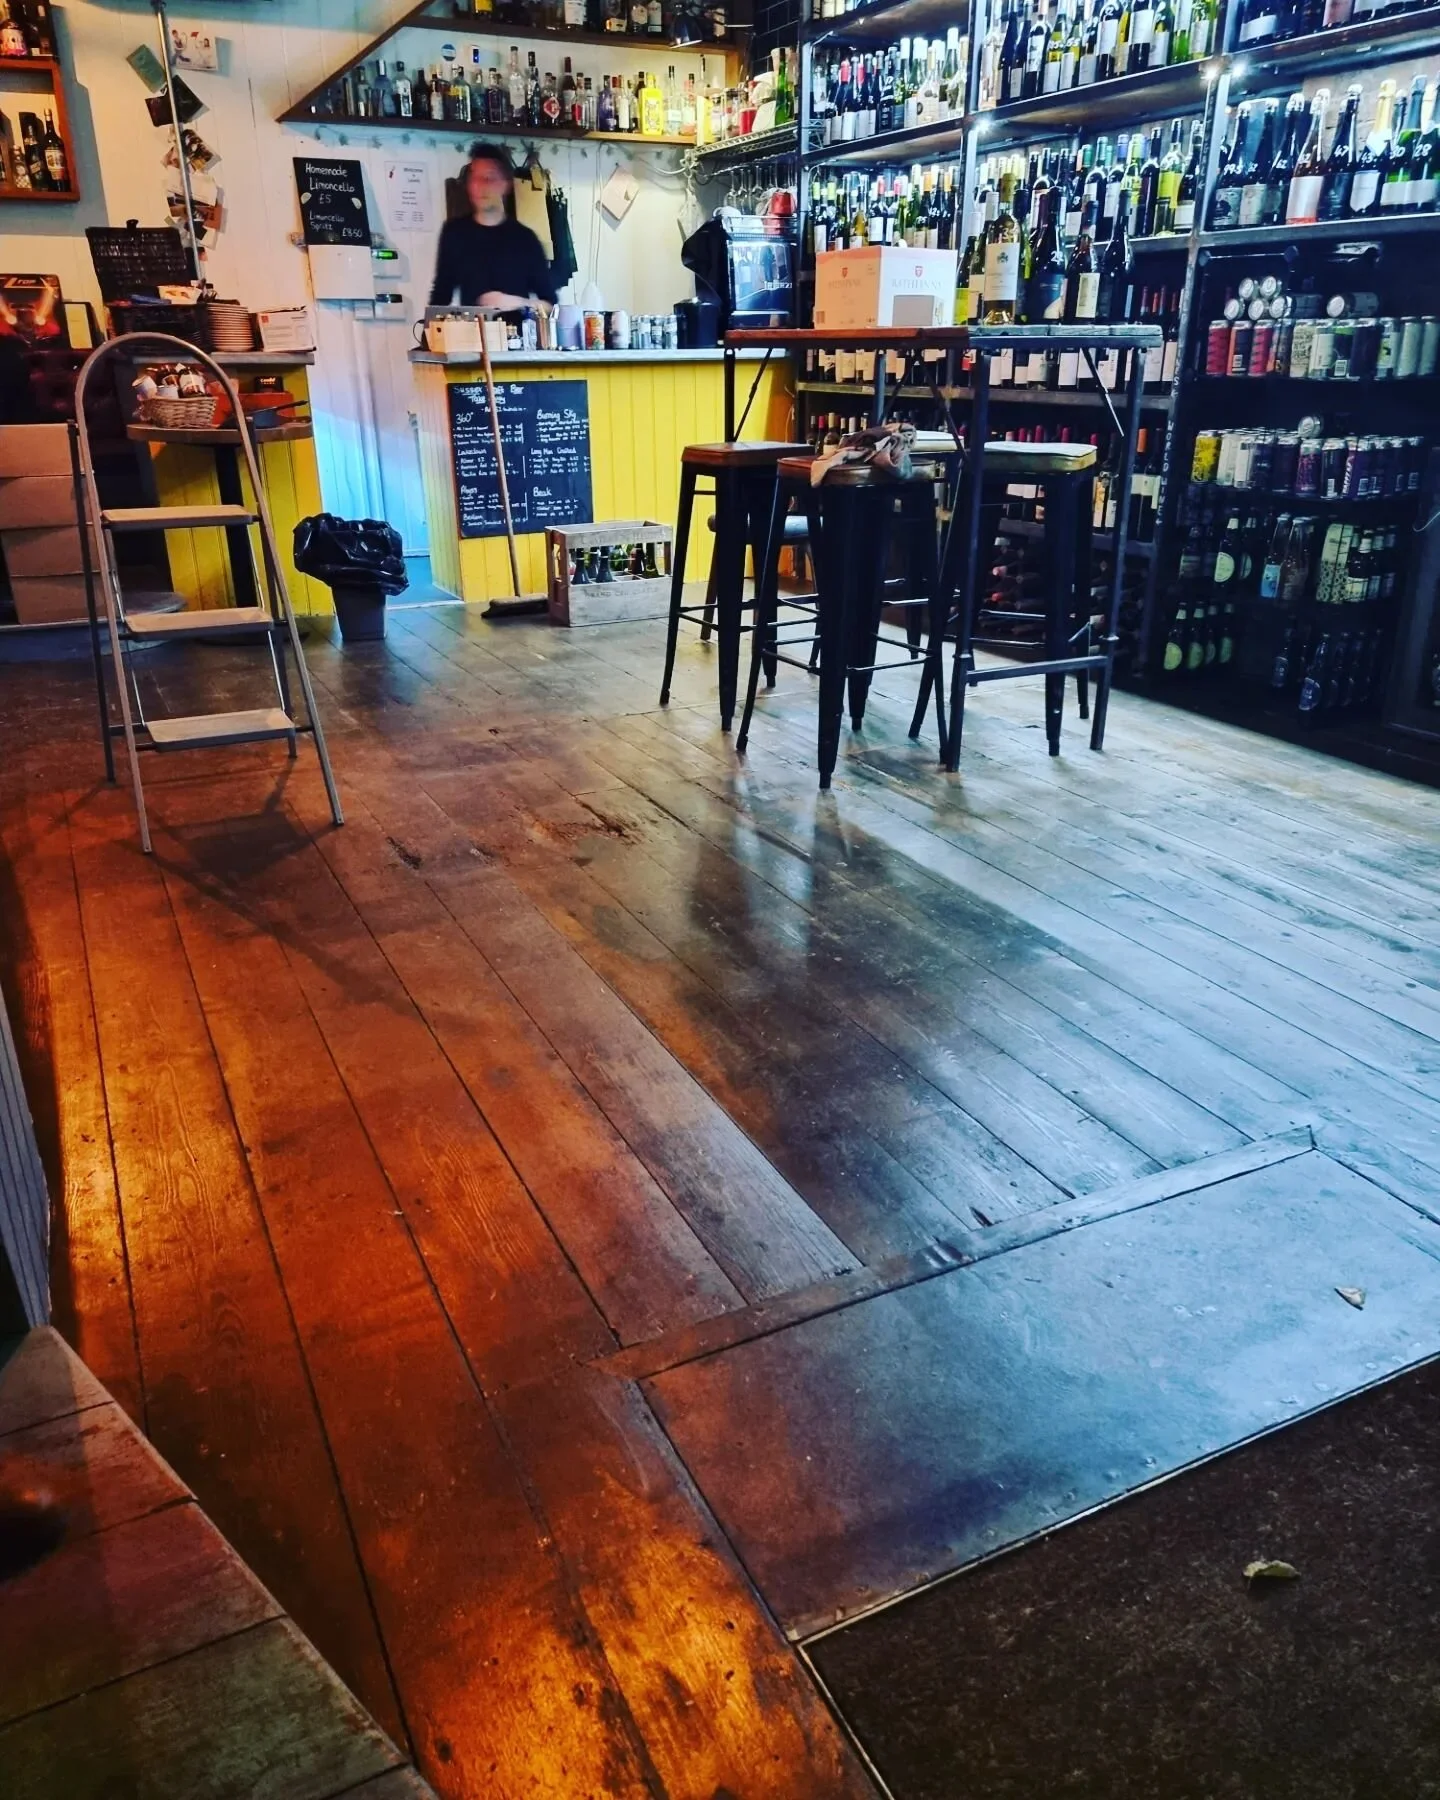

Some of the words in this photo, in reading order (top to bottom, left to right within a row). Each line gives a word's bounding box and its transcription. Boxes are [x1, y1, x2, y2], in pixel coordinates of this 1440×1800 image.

[305, 162, 348, 177] Homemade
[309, 177, 355, 192] Limoncello
[319, 193, 332, 204] £5
[309, 211, 345, 222] Limoncello
[310, 221, 333, 231] Spritz
[536, 409, 561, 422] Burning
[563, 408, 577, 421] Sky
[1163, 420, 1174, 472] WORLD
[533, 486, 552, 497] Beak
